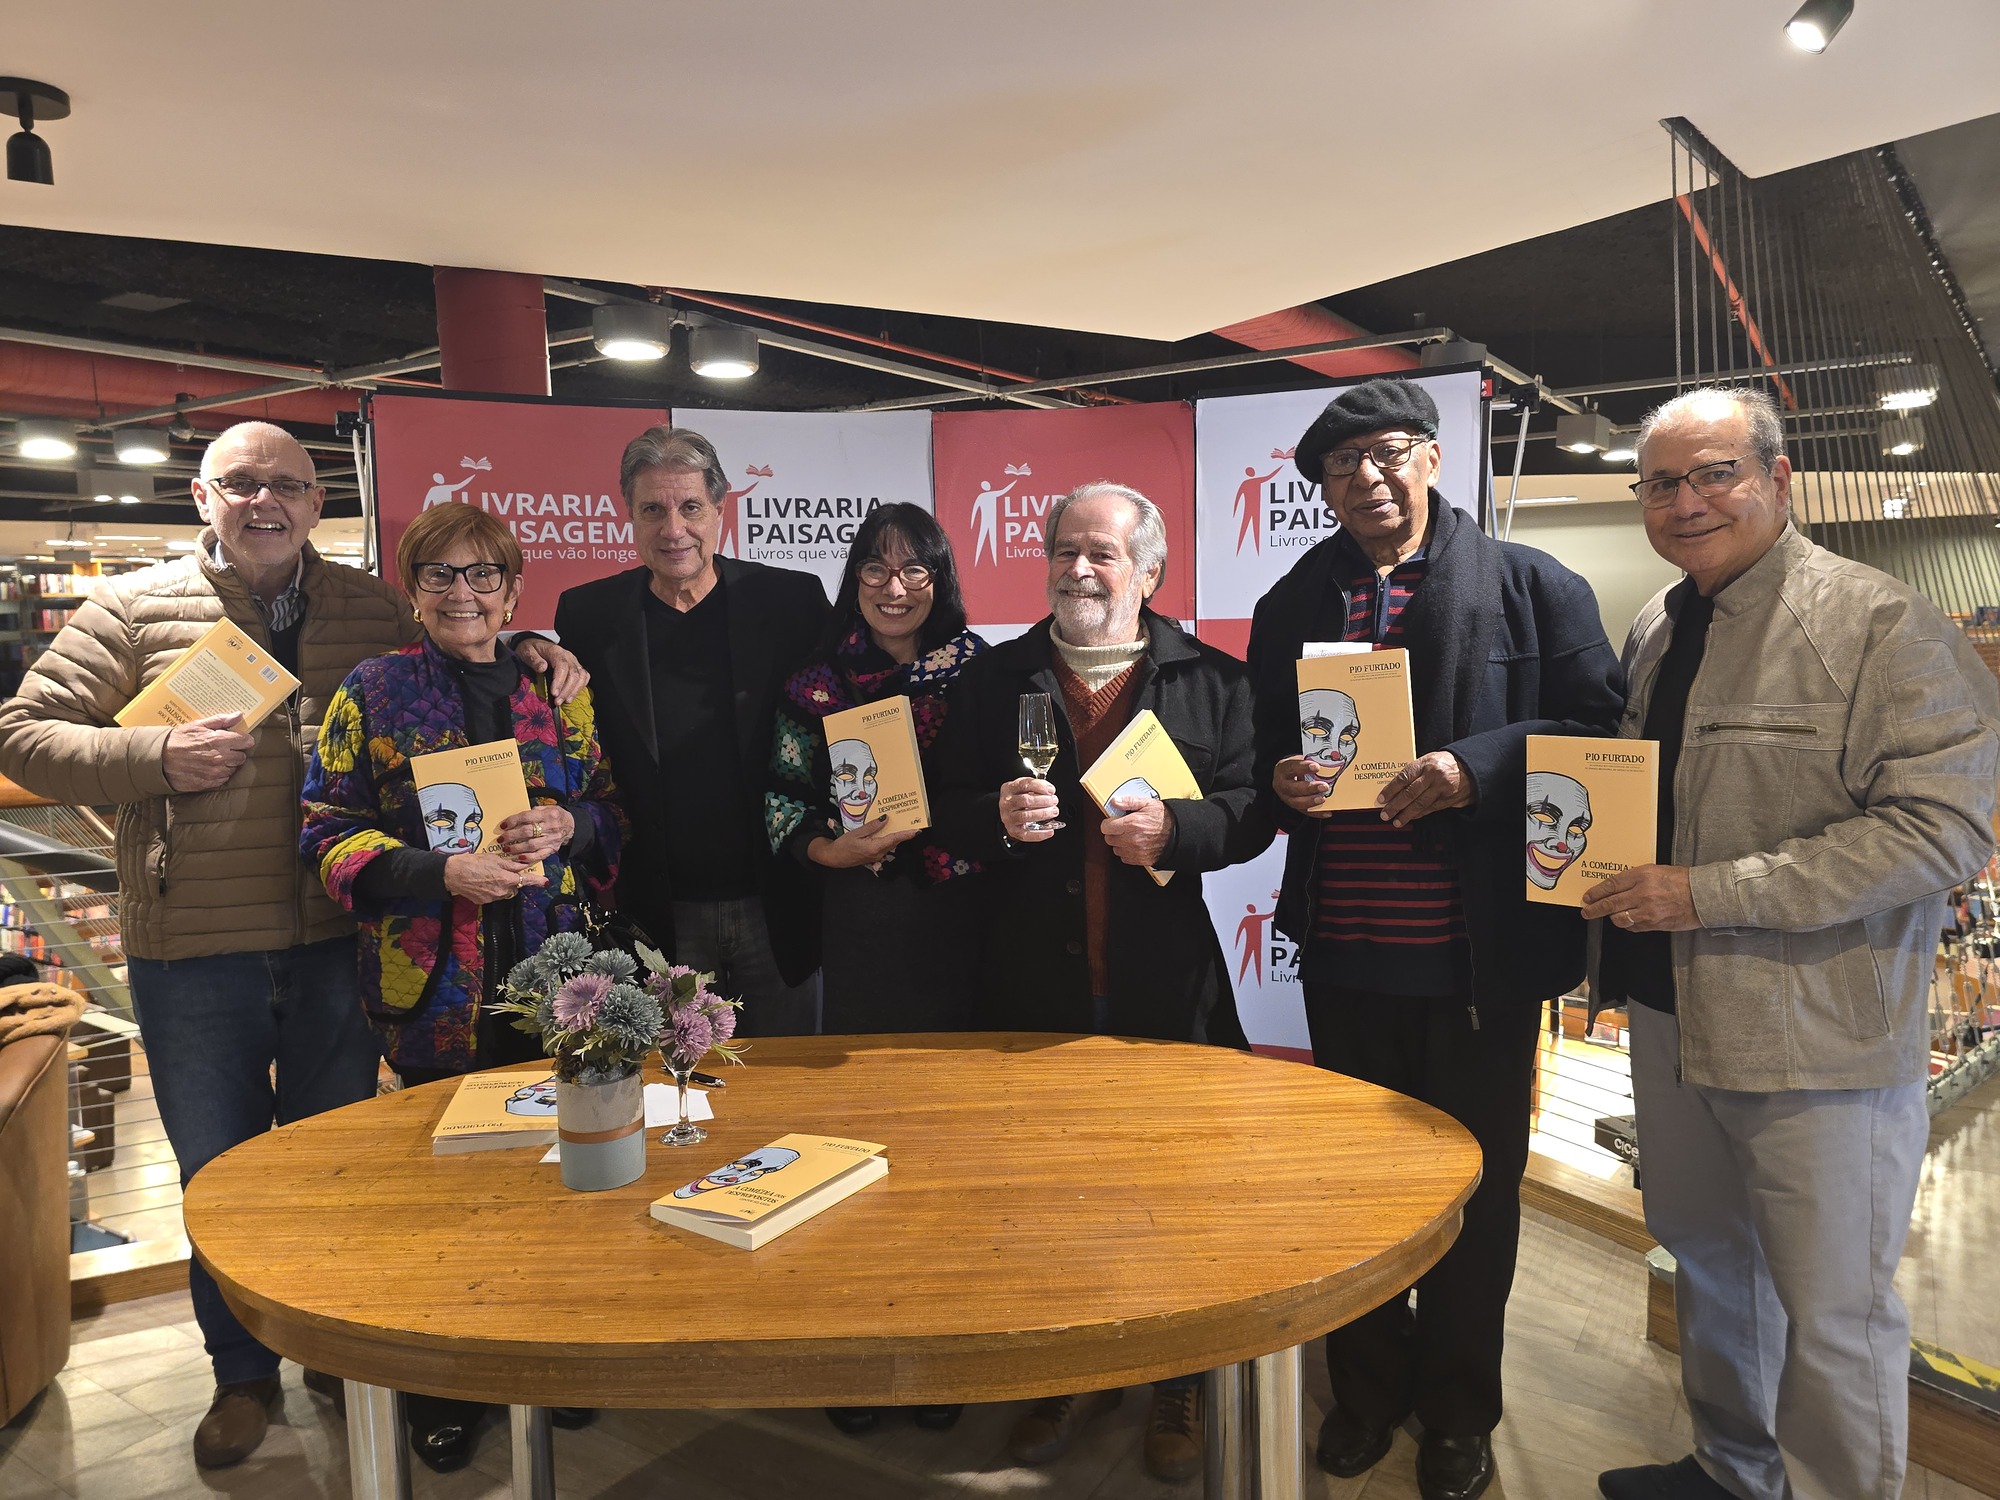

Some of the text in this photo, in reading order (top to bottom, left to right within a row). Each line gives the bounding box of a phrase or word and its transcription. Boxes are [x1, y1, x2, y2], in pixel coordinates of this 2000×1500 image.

[1270, 481, 1325, 504] LIV
[747, 523, 862, 544] PAISAG
[1270, 534, 1317, 547] Livros
[521, 546, 637, 563] que vão longe
[749, 548, 794, 559] Livros
[798, 549, 827, 562] que
[1349, 662, 1401, 674] PIO FURTADO
[862, 714, 873, 723] PIO
[872, 706, 900, 720] FURTADO
[1124, 748, 1135, 760] PIO
[1133, 723, 1157, 751] FURTADO
[465, 751, 514, 767] PIO FURTADO
[1585, 752, 1645, 764] PIO FURTADO
[1353, 764, 1359, 772] A
[1361, 760, 1397, 772] COMÉDIA
[1354, 771, 1401, 781] DESPROPÓS
[1581, 860, 1629, 872] A COMÉDIA
